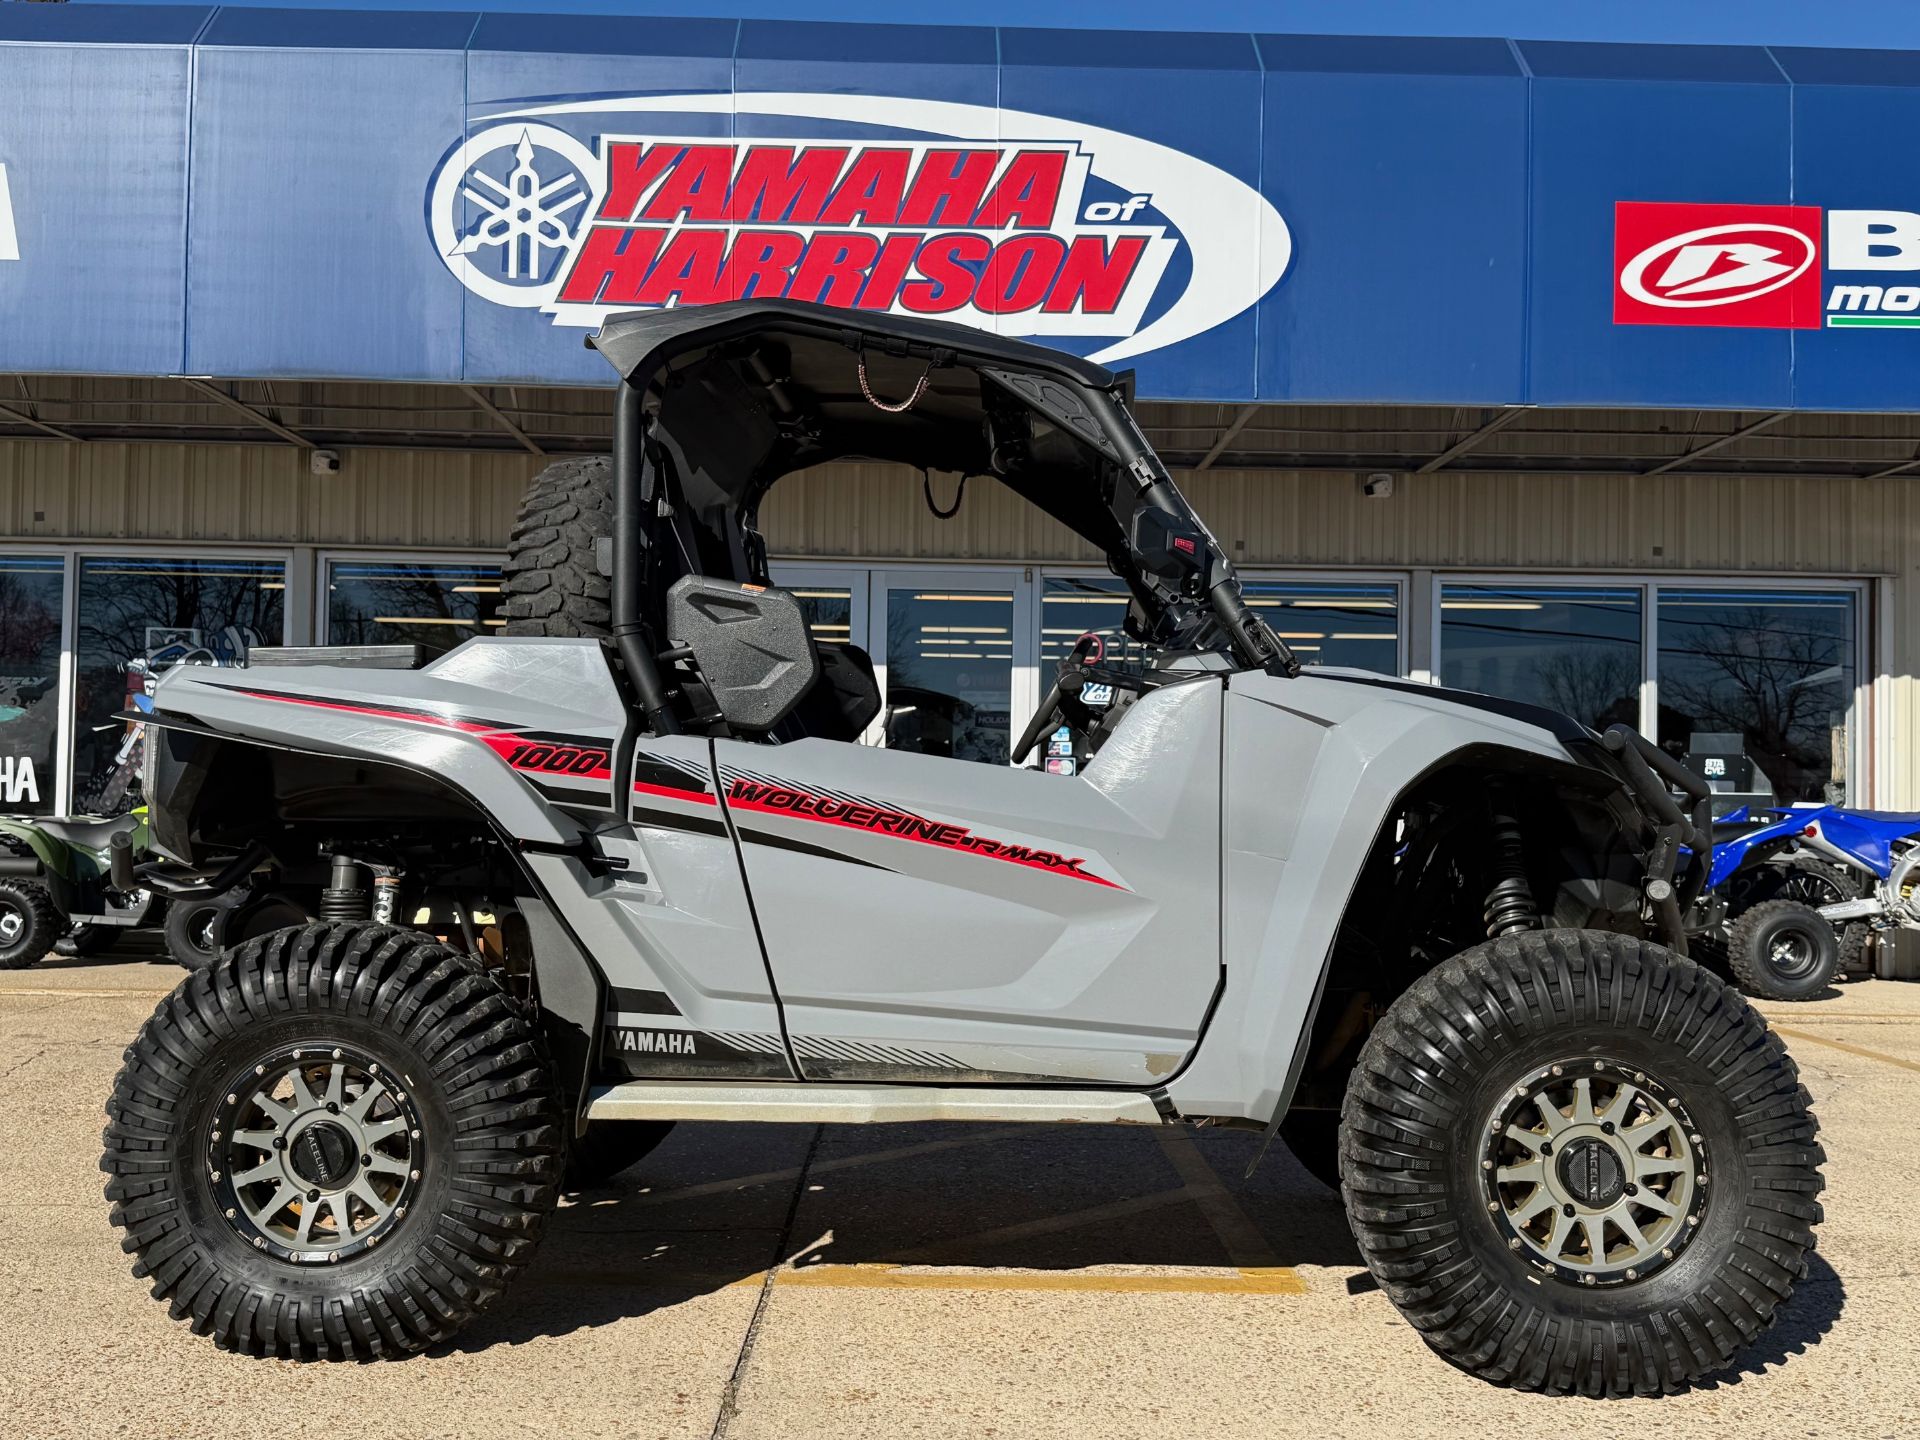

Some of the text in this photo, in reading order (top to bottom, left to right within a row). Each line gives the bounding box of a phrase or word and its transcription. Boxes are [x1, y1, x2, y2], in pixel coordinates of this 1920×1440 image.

[595, 142, 1149, 228] YAMAHA of
[556, 226, 1151, 315] HARRISON
[507, 744, 605, 775] 1000
[731, 780, 971, 846] WOLVERINE
[612, 1029, 696, 1055] YAMAHA
[304, 1128, 330, 1183] RACELINE
[1589, 1143, 1599, 1201] RACELINE
